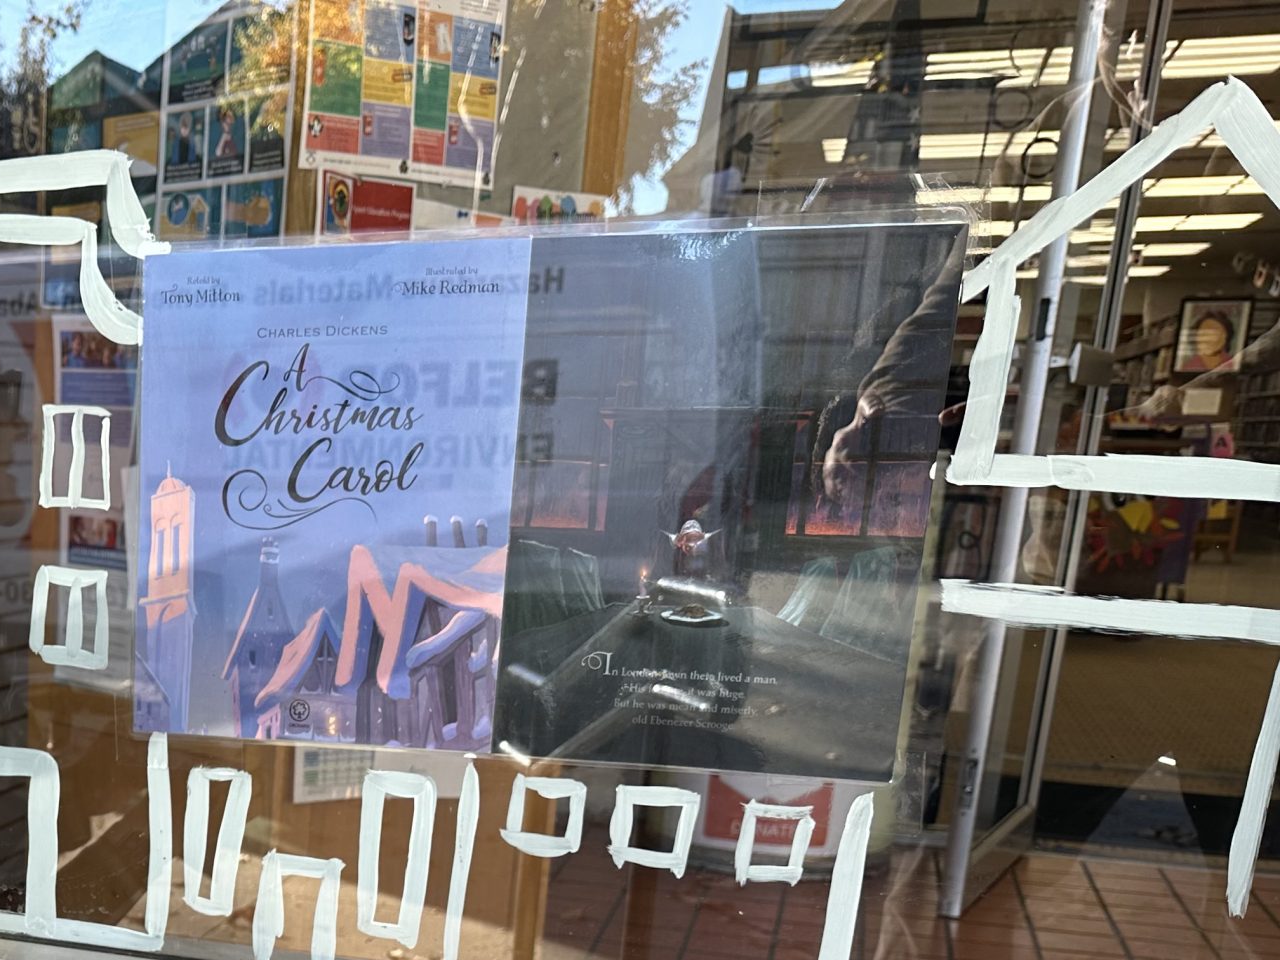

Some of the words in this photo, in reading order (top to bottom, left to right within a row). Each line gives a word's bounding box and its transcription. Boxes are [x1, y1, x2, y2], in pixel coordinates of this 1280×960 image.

[426, 267, 466, 276] Illustrated
[187, 276, 211, 286] Retold
[395, 280, 436, 296] Mike
[440, 279, 500, 295] Redman
[161, 284, 193, 307] Tony
[196, 288, 240, 304] Mitton
[257, 327, 320, 338] CHARLES
[326, 325, 388, 337] DICKENS
[215, 360, 423, 447] Christmas
[288, 438, 424, 502] Carol
[581, 651, 618, 676] In
[718, 672, 742, 683] lived
[697, 689, 716, 698] was
[632, 699, 644, 709] he
[647, 702, 666, 710] was
[632, 715, 648, 725] old
[651, 716, 693, 728] Ebenezer
